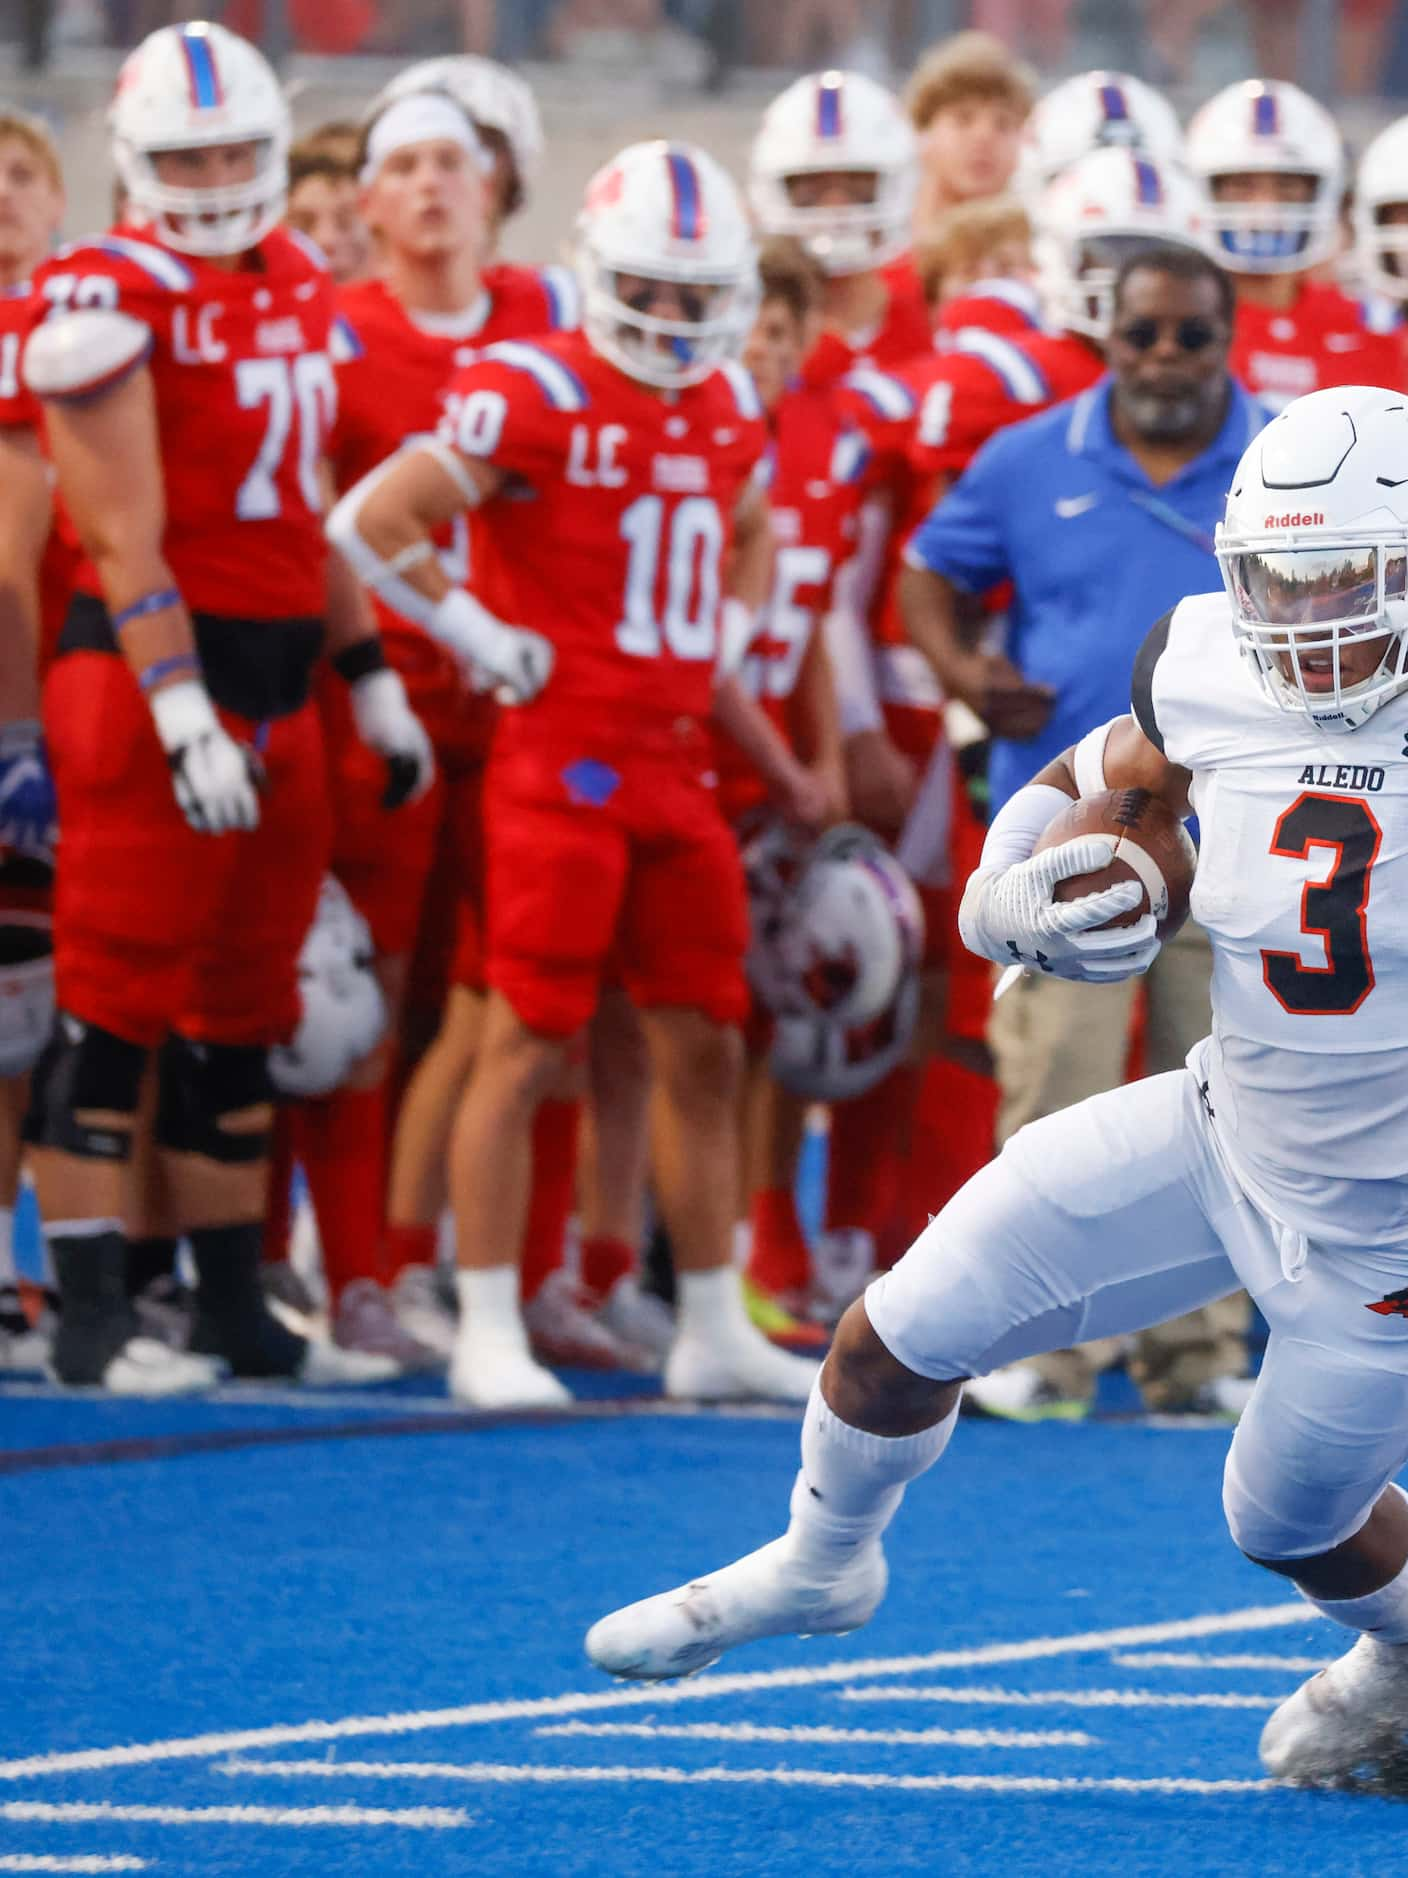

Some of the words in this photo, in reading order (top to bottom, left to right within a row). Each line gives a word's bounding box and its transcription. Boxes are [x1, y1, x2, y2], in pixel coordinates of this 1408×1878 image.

[566, 423, 628, 488] LC
[1264, 512, 1325, 529] Riddell
[614, 494, 723, 661] 10
[1297, 764, 1385, 792] ALEDO
[1259, 790, 1383, 1016] 3
